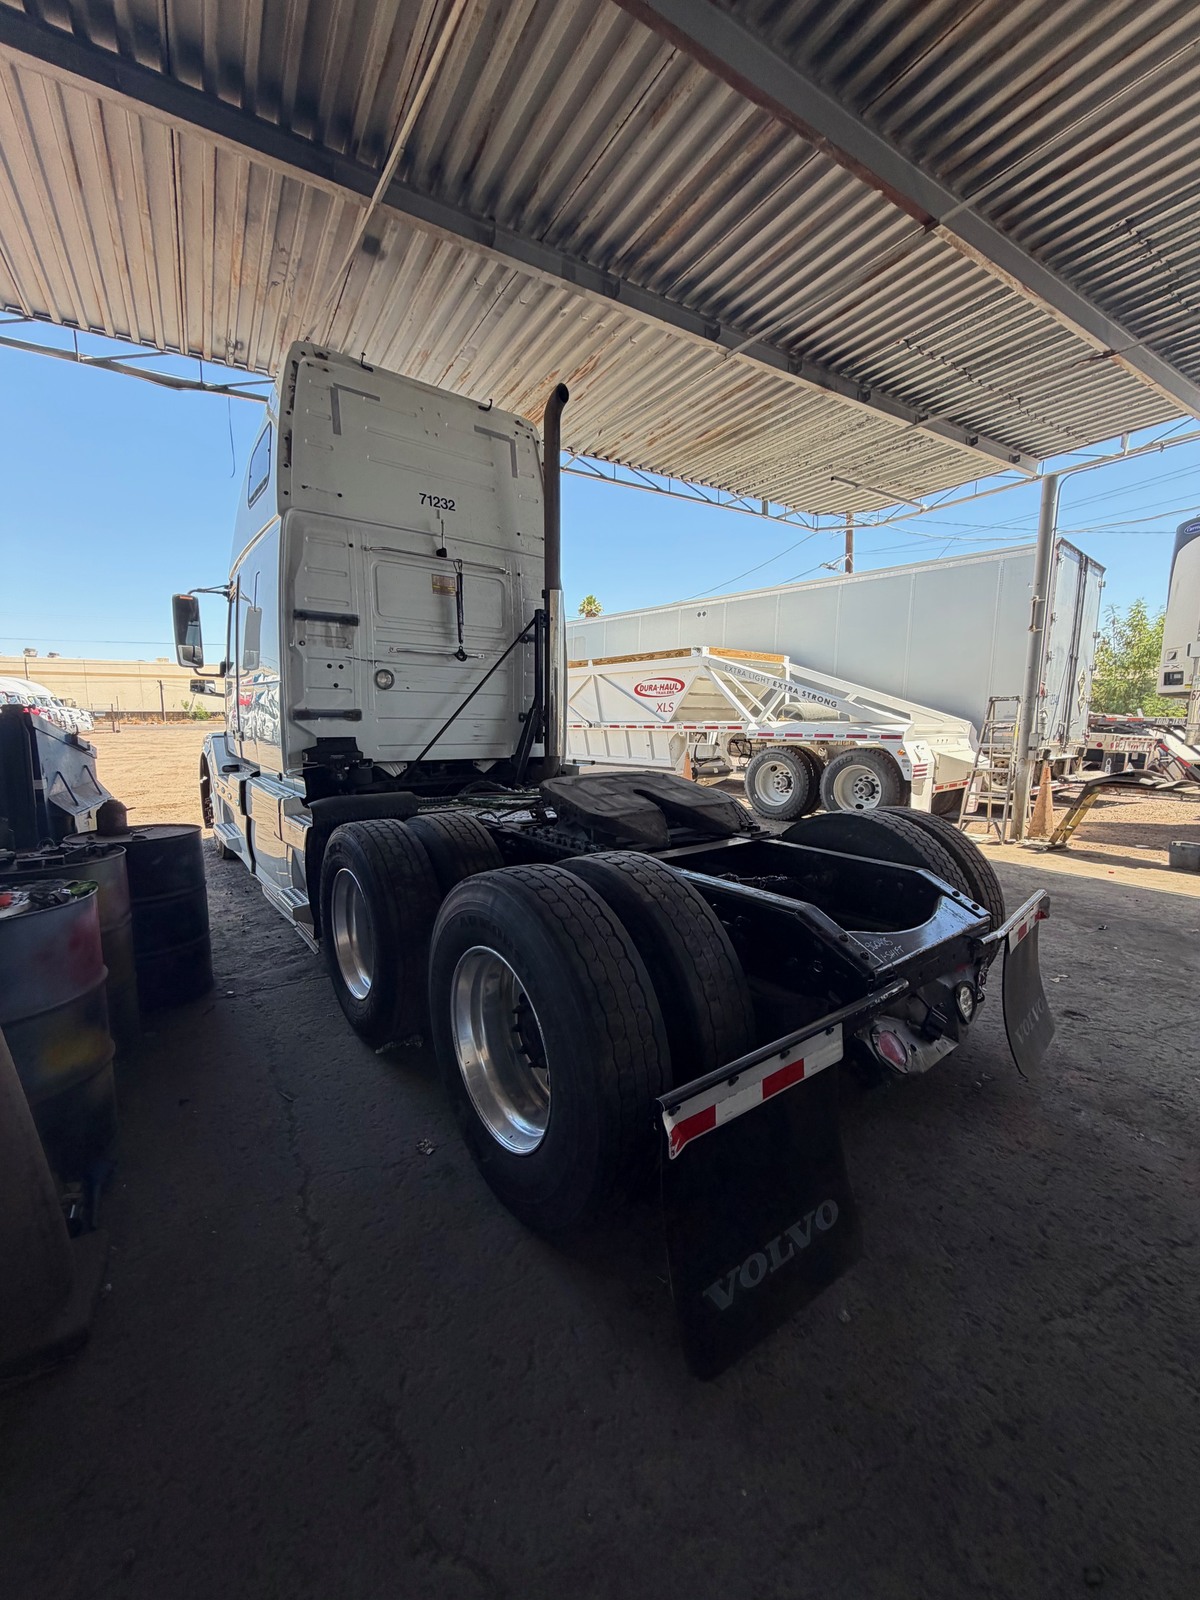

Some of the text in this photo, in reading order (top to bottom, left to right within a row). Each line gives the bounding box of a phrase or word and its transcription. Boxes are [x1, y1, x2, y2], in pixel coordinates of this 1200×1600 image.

[419, 492, 456, 512] 71232
[639, 682, 679, 692] DURA-HAUL
[724, 664, 838, 708] EXTRA LIGHT EXTRA STRONG
[656, 702, 675, 713] XLS
[702, 1199, 839, 1311] VOLVO
